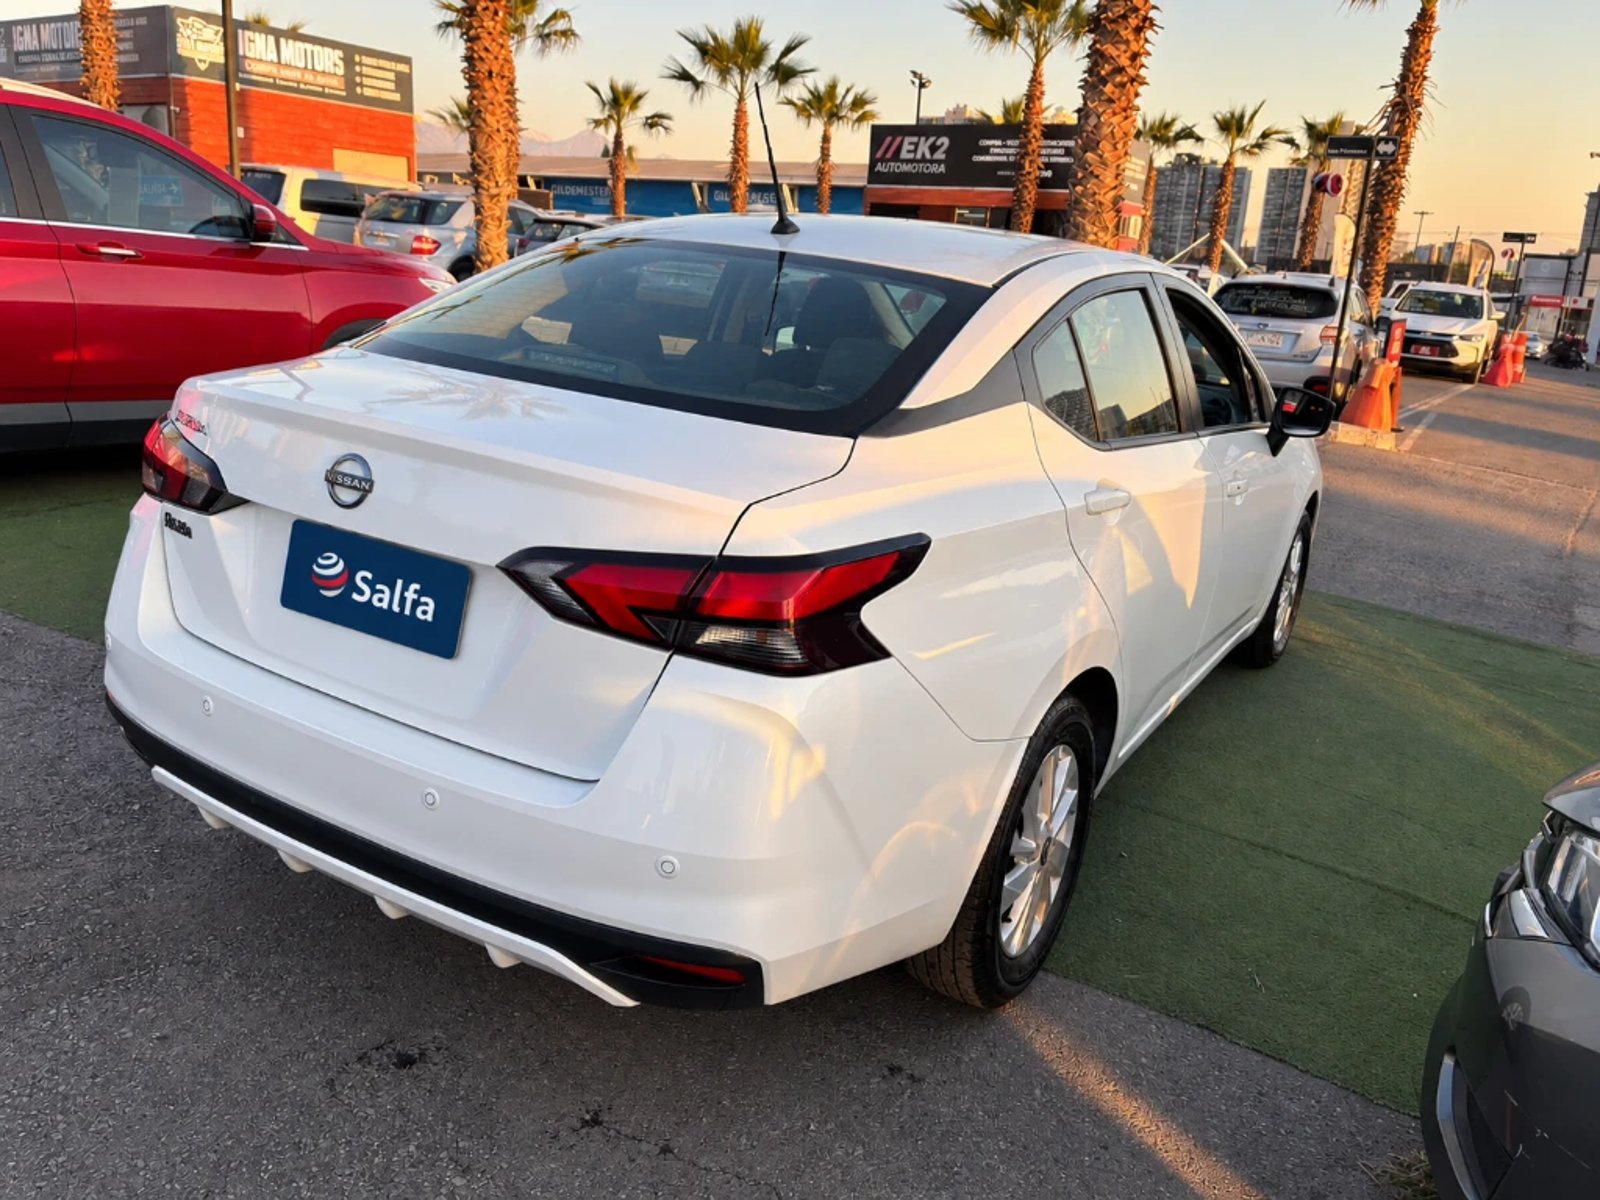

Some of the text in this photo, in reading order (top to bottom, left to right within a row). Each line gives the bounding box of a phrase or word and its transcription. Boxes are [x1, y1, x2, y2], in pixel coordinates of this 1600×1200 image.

[237, 29, 279, 63] IGNA
[279, 36, 345, 76] MOTORS
[874, 161, 946, 174] AUTOMOTORA
[326, 470, 372, 491] NISSAN
[351, 569, 436, 623] Salfa
